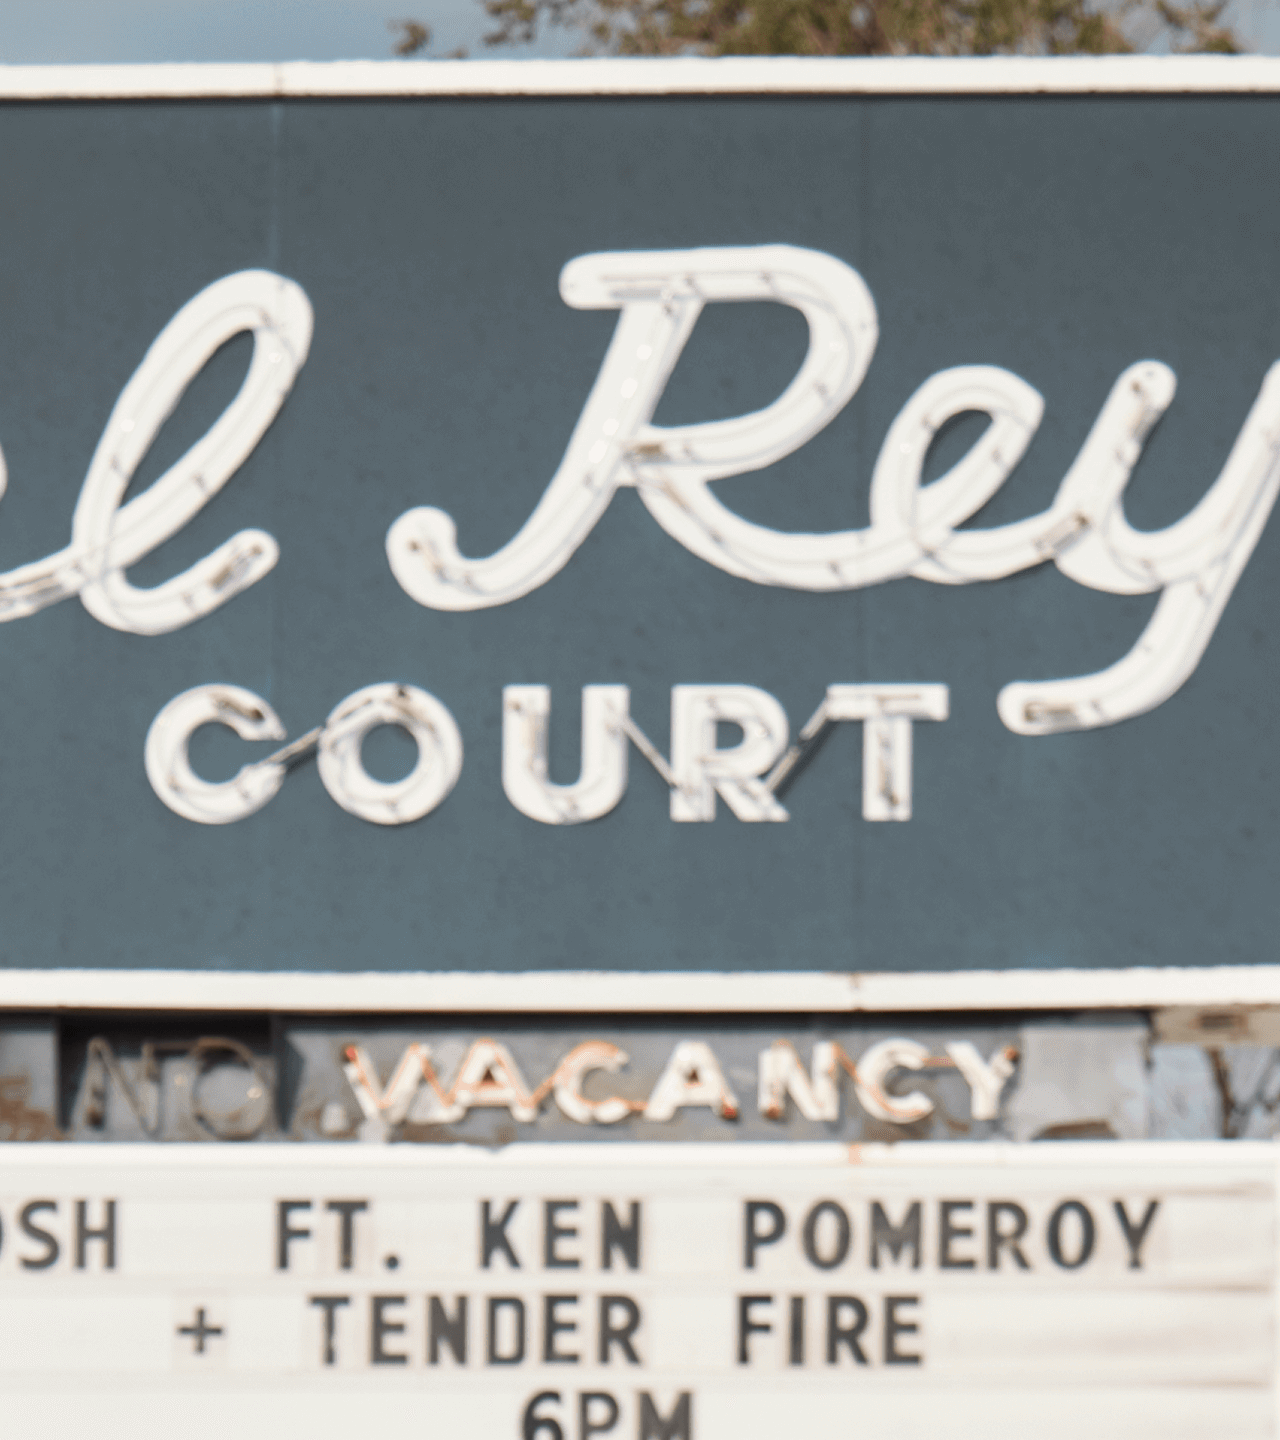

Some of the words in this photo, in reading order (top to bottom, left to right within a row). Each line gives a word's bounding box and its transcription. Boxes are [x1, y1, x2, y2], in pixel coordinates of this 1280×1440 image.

[144, 682, 949, 824] COURT
[78, 1036, 272, 1141] NO
[340, 1038, 1020, 1125] VACANCY
[276, 1199, 400, 1272] FT.
[480, 1199, 642, 1271] KEN
[743, 1198, 1161, 1272] POMEROY
[309, 1293, 642, 1366] TENDER
[737, 1294, 922, 1366] FIRE
